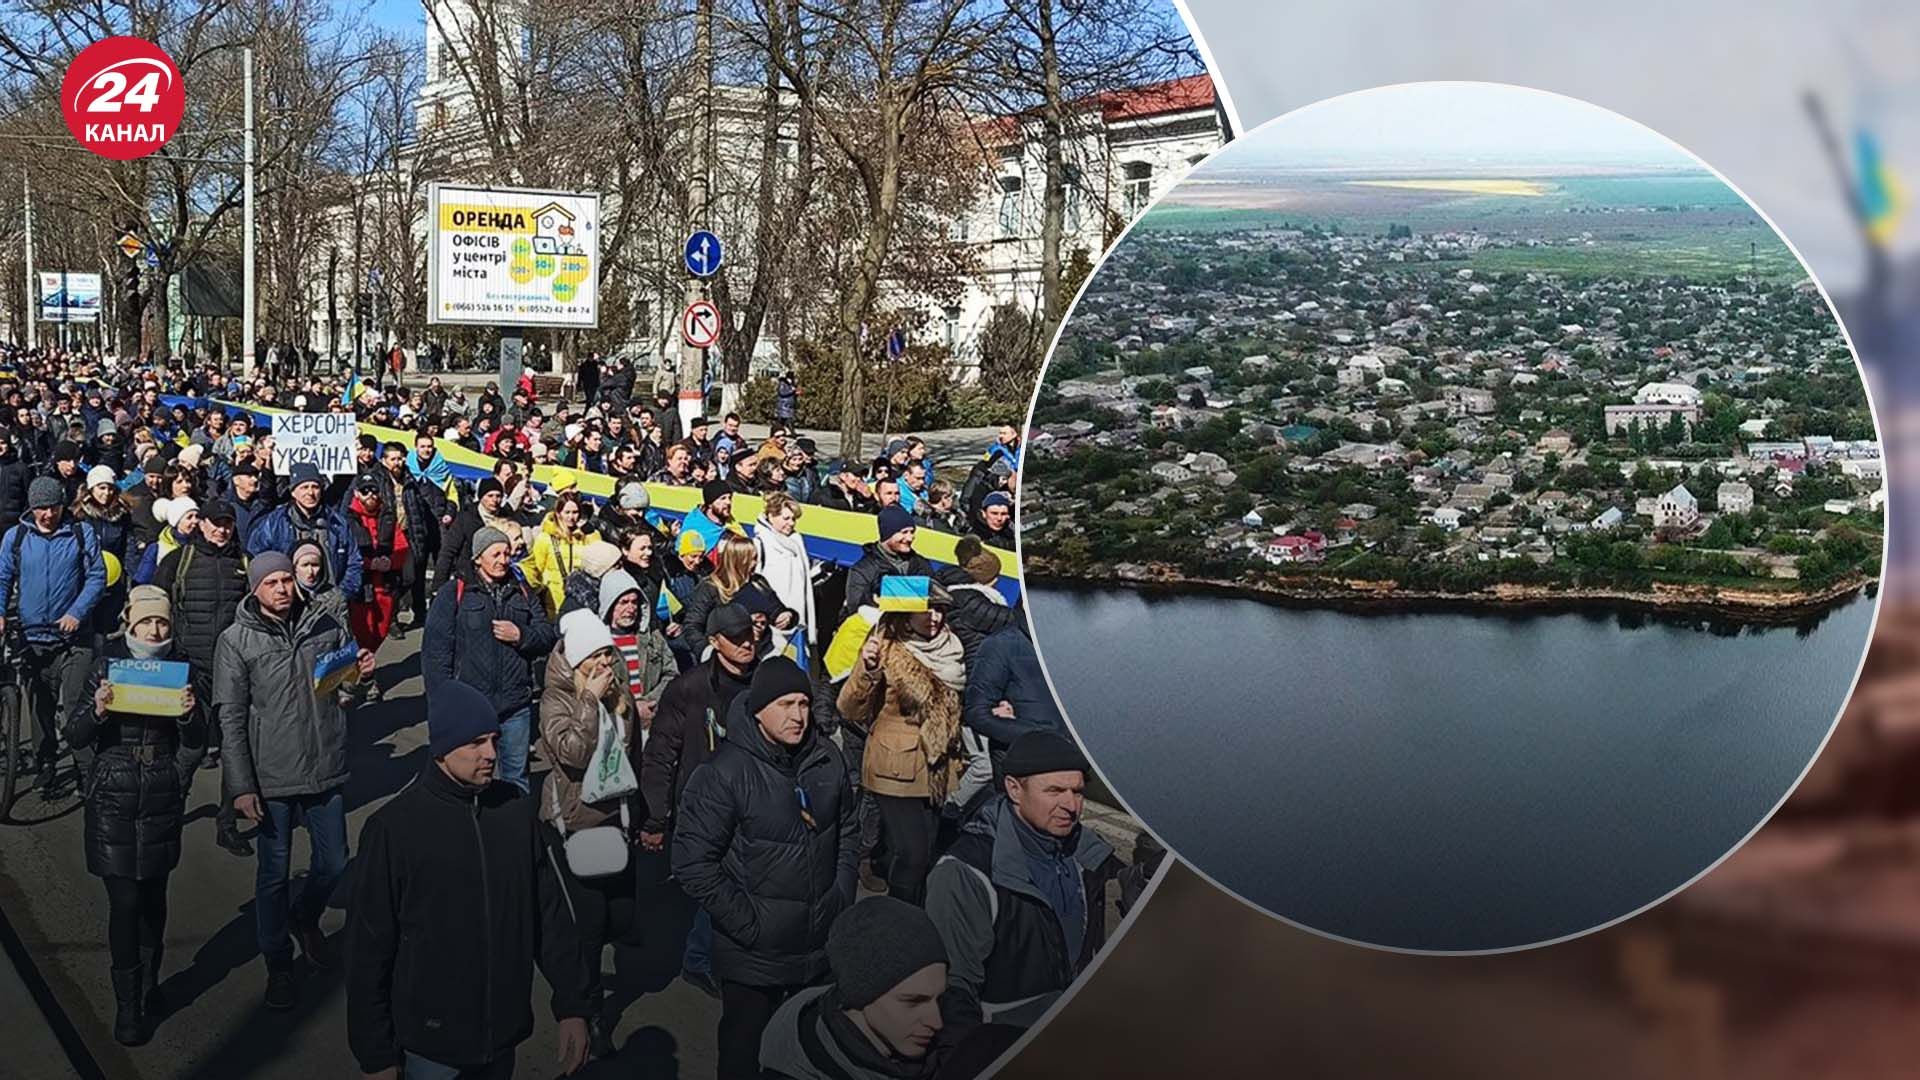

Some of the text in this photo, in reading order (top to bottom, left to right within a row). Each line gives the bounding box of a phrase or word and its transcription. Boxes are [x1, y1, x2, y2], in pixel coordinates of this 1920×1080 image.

[452, 210, 526, 231] ОРЕНДА
[452, 234, 500, 248] ОФІСІВ
[453, 250, 507, 266] у центрі
[452, 265, 488, 279] міста
[302, 435, 318, 446] це
[276, 443, 353, 471] УКРАЇНА
